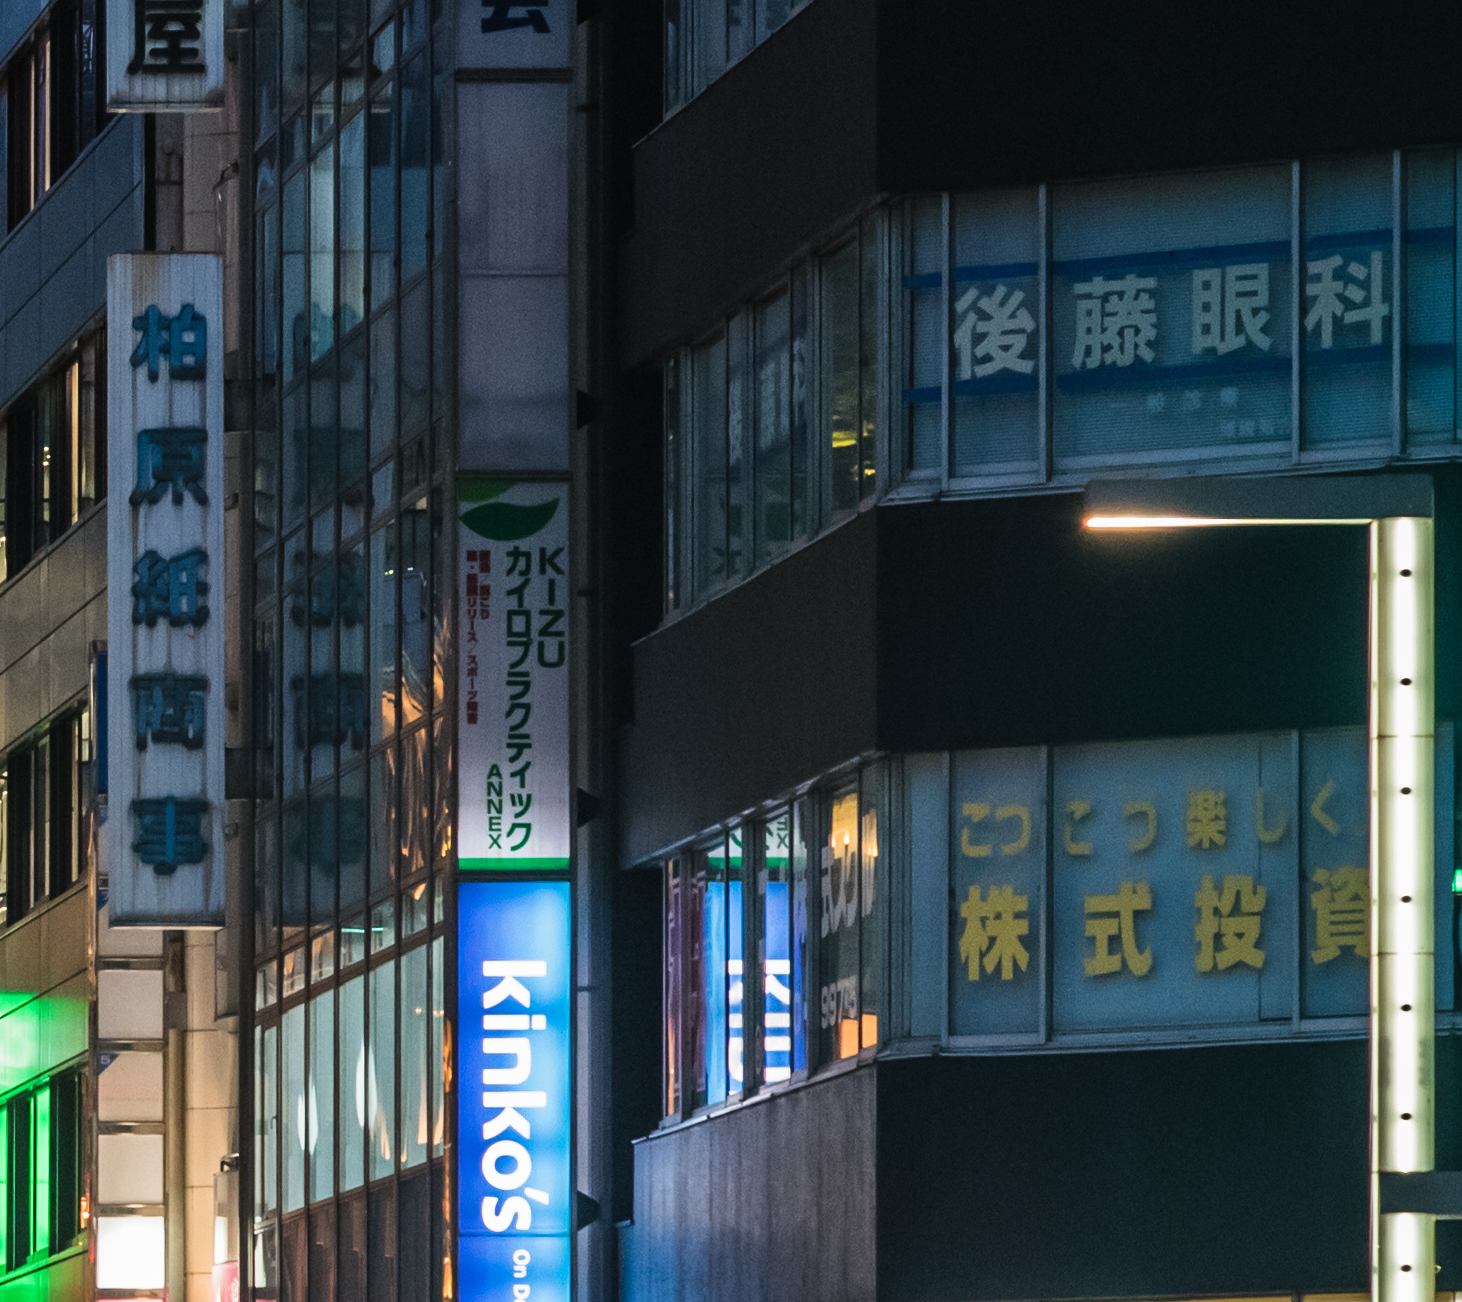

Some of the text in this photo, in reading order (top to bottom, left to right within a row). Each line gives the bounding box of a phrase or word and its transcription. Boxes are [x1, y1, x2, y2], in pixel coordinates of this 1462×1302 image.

[954, 251, 1390, 381] 後藤眼科
[538, 547, 565, 668] KIZU
[506, 546, 533, 852] カイロプラクティック
[486, 764, 503, 850] ANNEX
[481, 960, 548, 1234] kinko's
[513, 1250, 531, 1278] On
